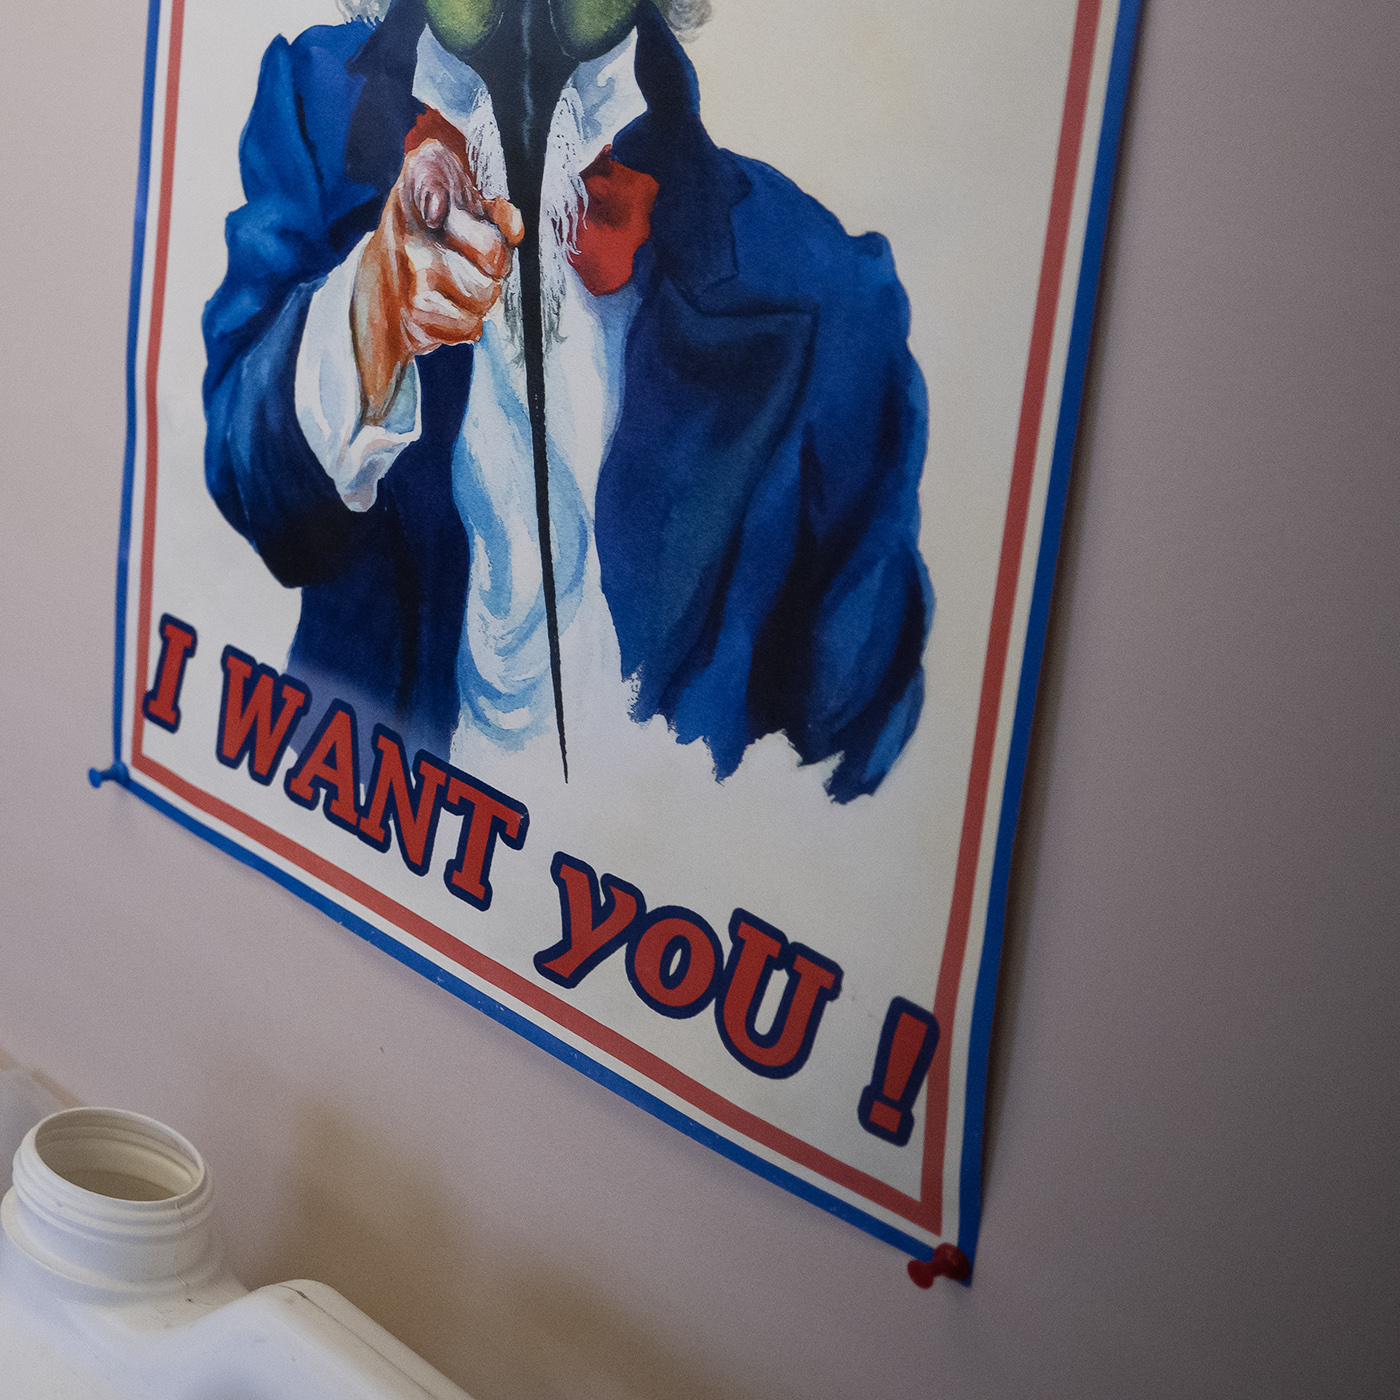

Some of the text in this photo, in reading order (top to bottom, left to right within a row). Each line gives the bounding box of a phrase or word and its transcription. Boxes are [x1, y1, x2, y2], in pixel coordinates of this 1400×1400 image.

[141, 612, 197, 732] I
[213, 644, 529, 912] WANT
[857, 996, 942, 1147] !
